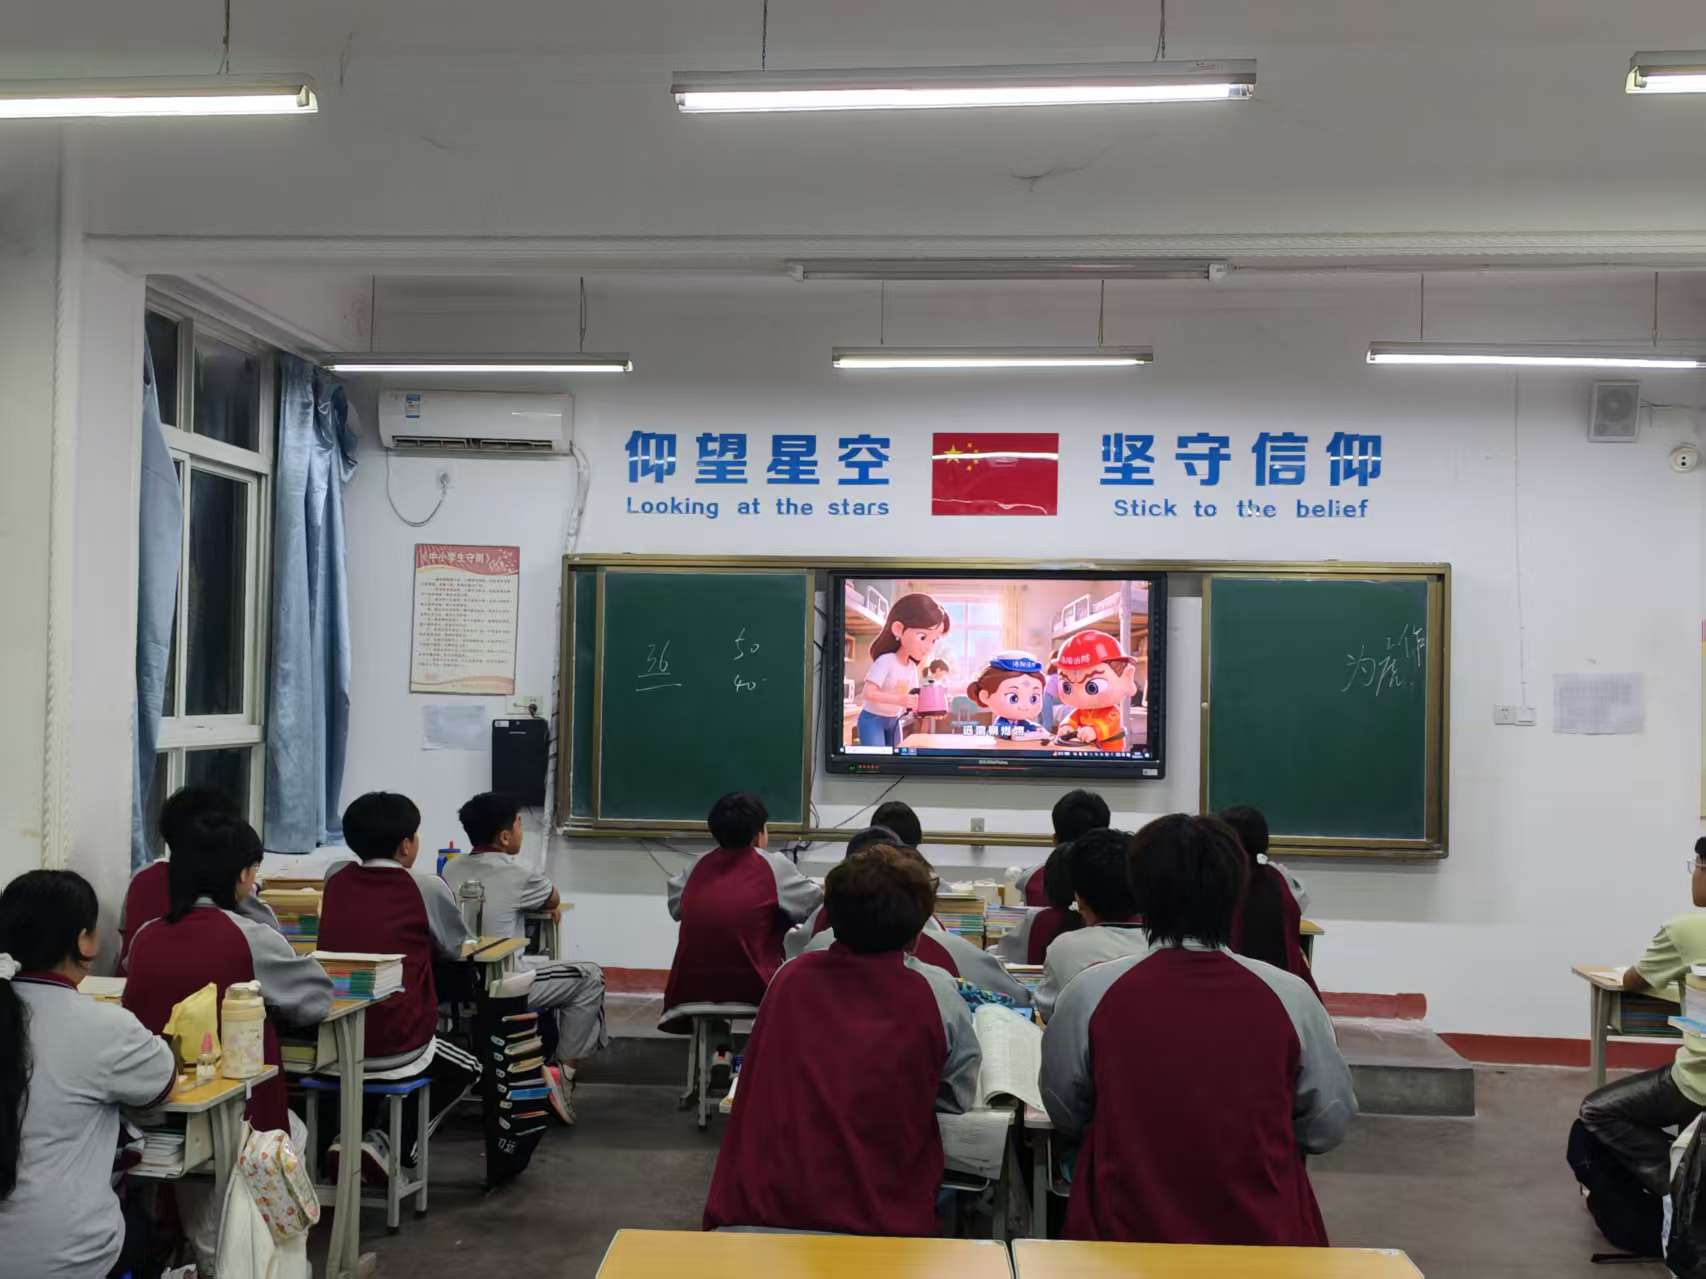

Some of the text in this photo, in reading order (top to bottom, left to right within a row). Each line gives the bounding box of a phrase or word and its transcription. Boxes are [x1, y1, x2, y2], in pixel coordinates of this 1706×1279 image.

[625, 430, 890, 485] 仰望星空
[1100, 431, 1382, 486] 坚守信仰
[626, 497, 889, 519] Looking at the stars
[1113, 499, 1369, 518] Stick to the belief
[733, 627, 760, 660] 50
[733, 673, 757, 692] 40
